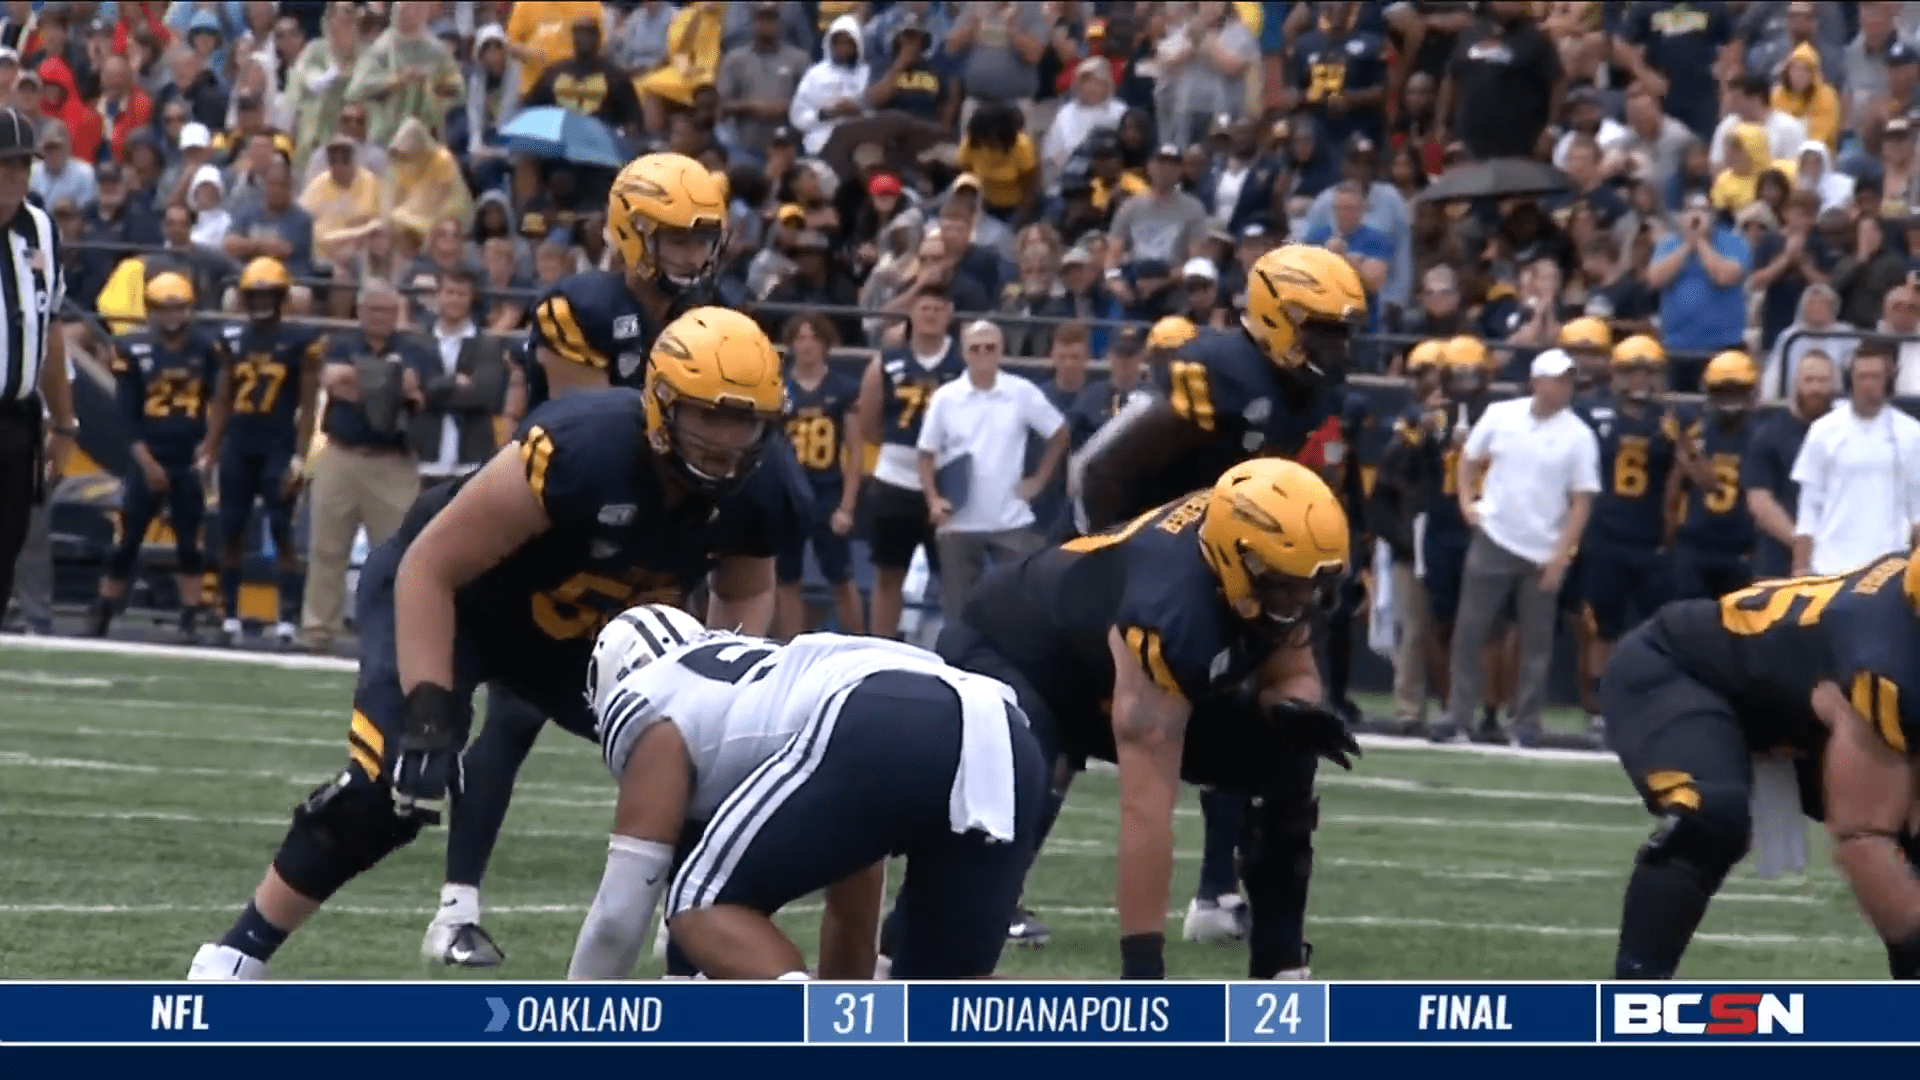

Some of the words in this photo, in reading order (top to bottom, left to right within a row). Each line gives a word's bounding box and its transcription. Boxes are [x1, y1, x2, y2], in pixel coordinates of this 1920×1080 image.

[144, 375, 200, 418] 24
[233, 361, 287, 415] 27
[893, 384, 930, 429] 7
[1613, 444, 1649, 497] 6
[1719, 572, 1846, 635] 5
